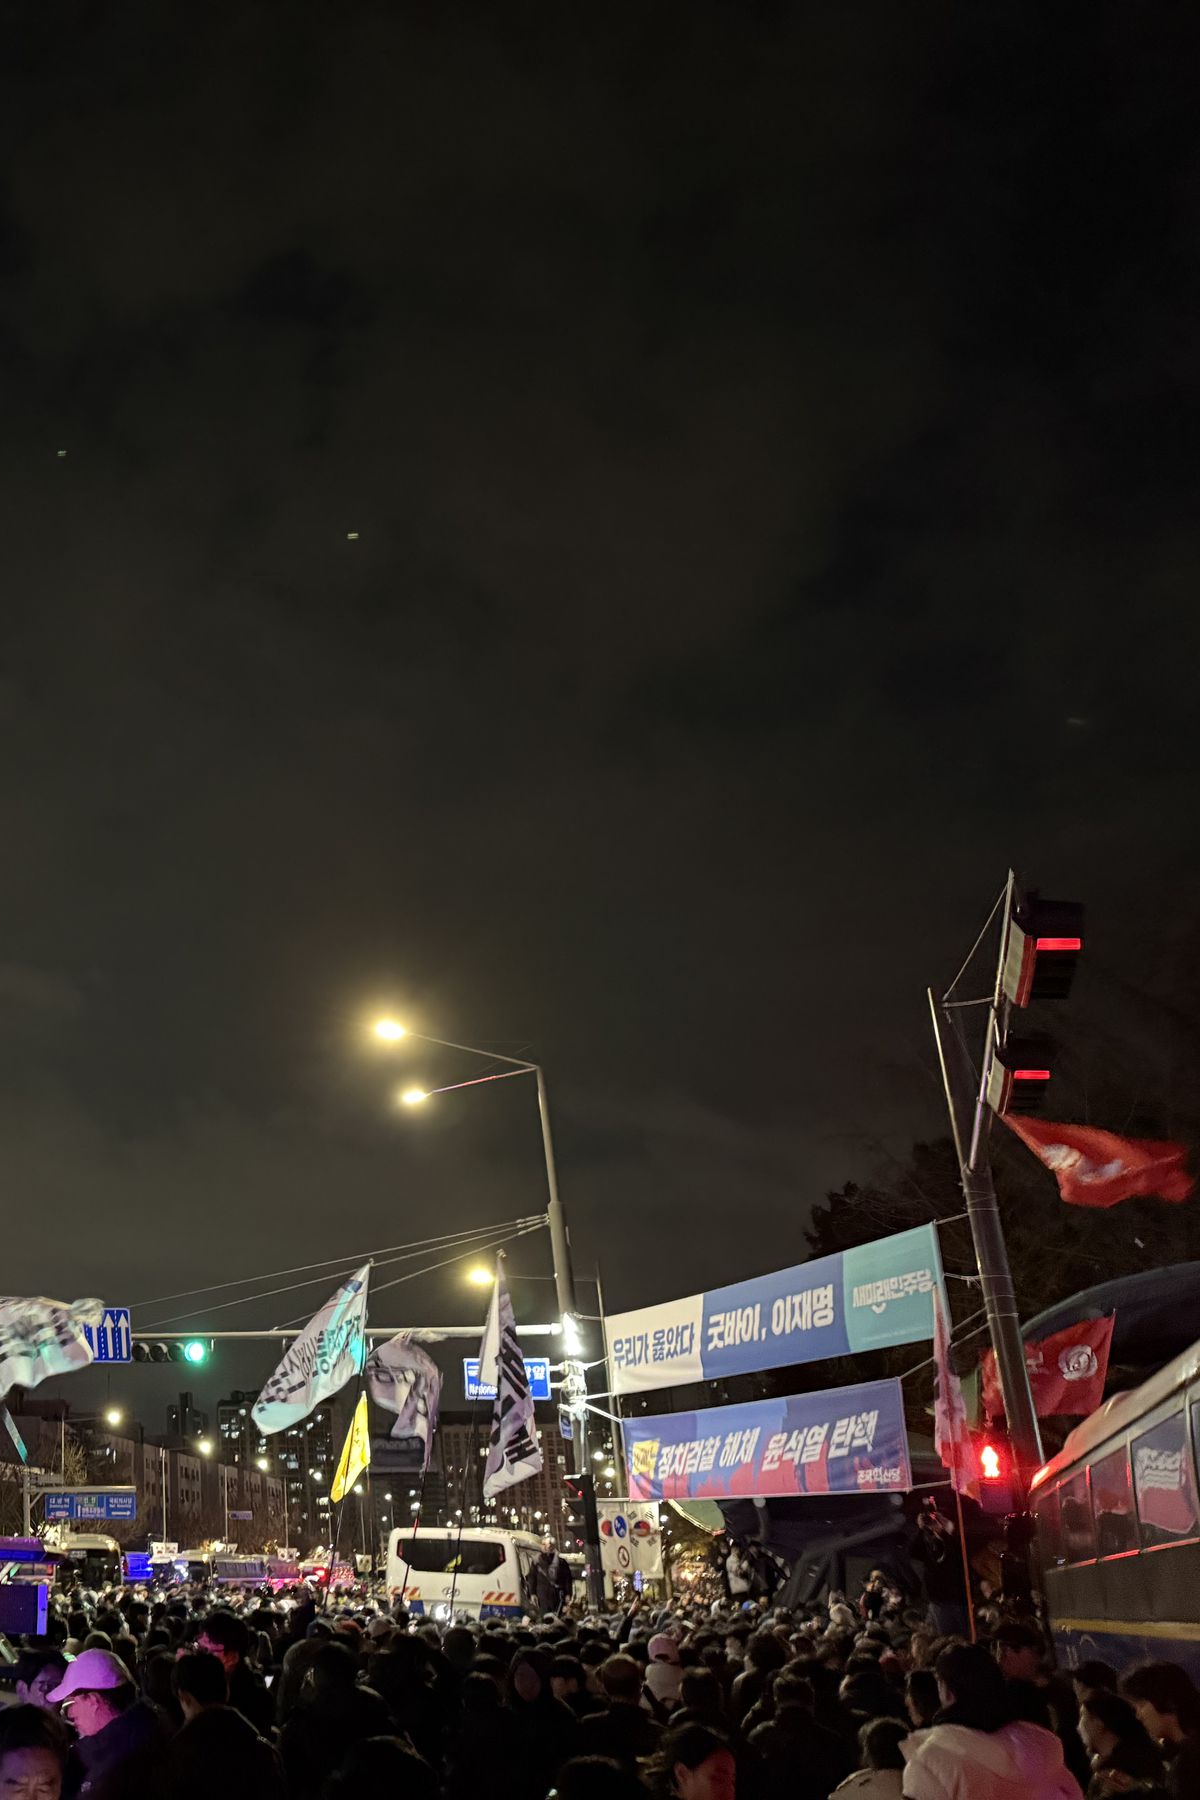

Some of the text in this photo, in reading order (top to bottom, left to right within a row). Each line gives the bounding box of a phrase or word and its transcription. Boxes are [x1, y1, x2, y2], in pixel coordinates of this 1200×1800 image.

[853, 1268, 933, 1308] 새미래민주당
[613, 1284, 835, 1369] 우리가 옳았다 굿바이, 이재명
[658, 1436, 721, 1480] 정치검찰
[719, 1426, 760, 1467] 해체
[762, 1422, 830, 1471] 윤석열
[828, 1409, 879, 1459] 탄핵
